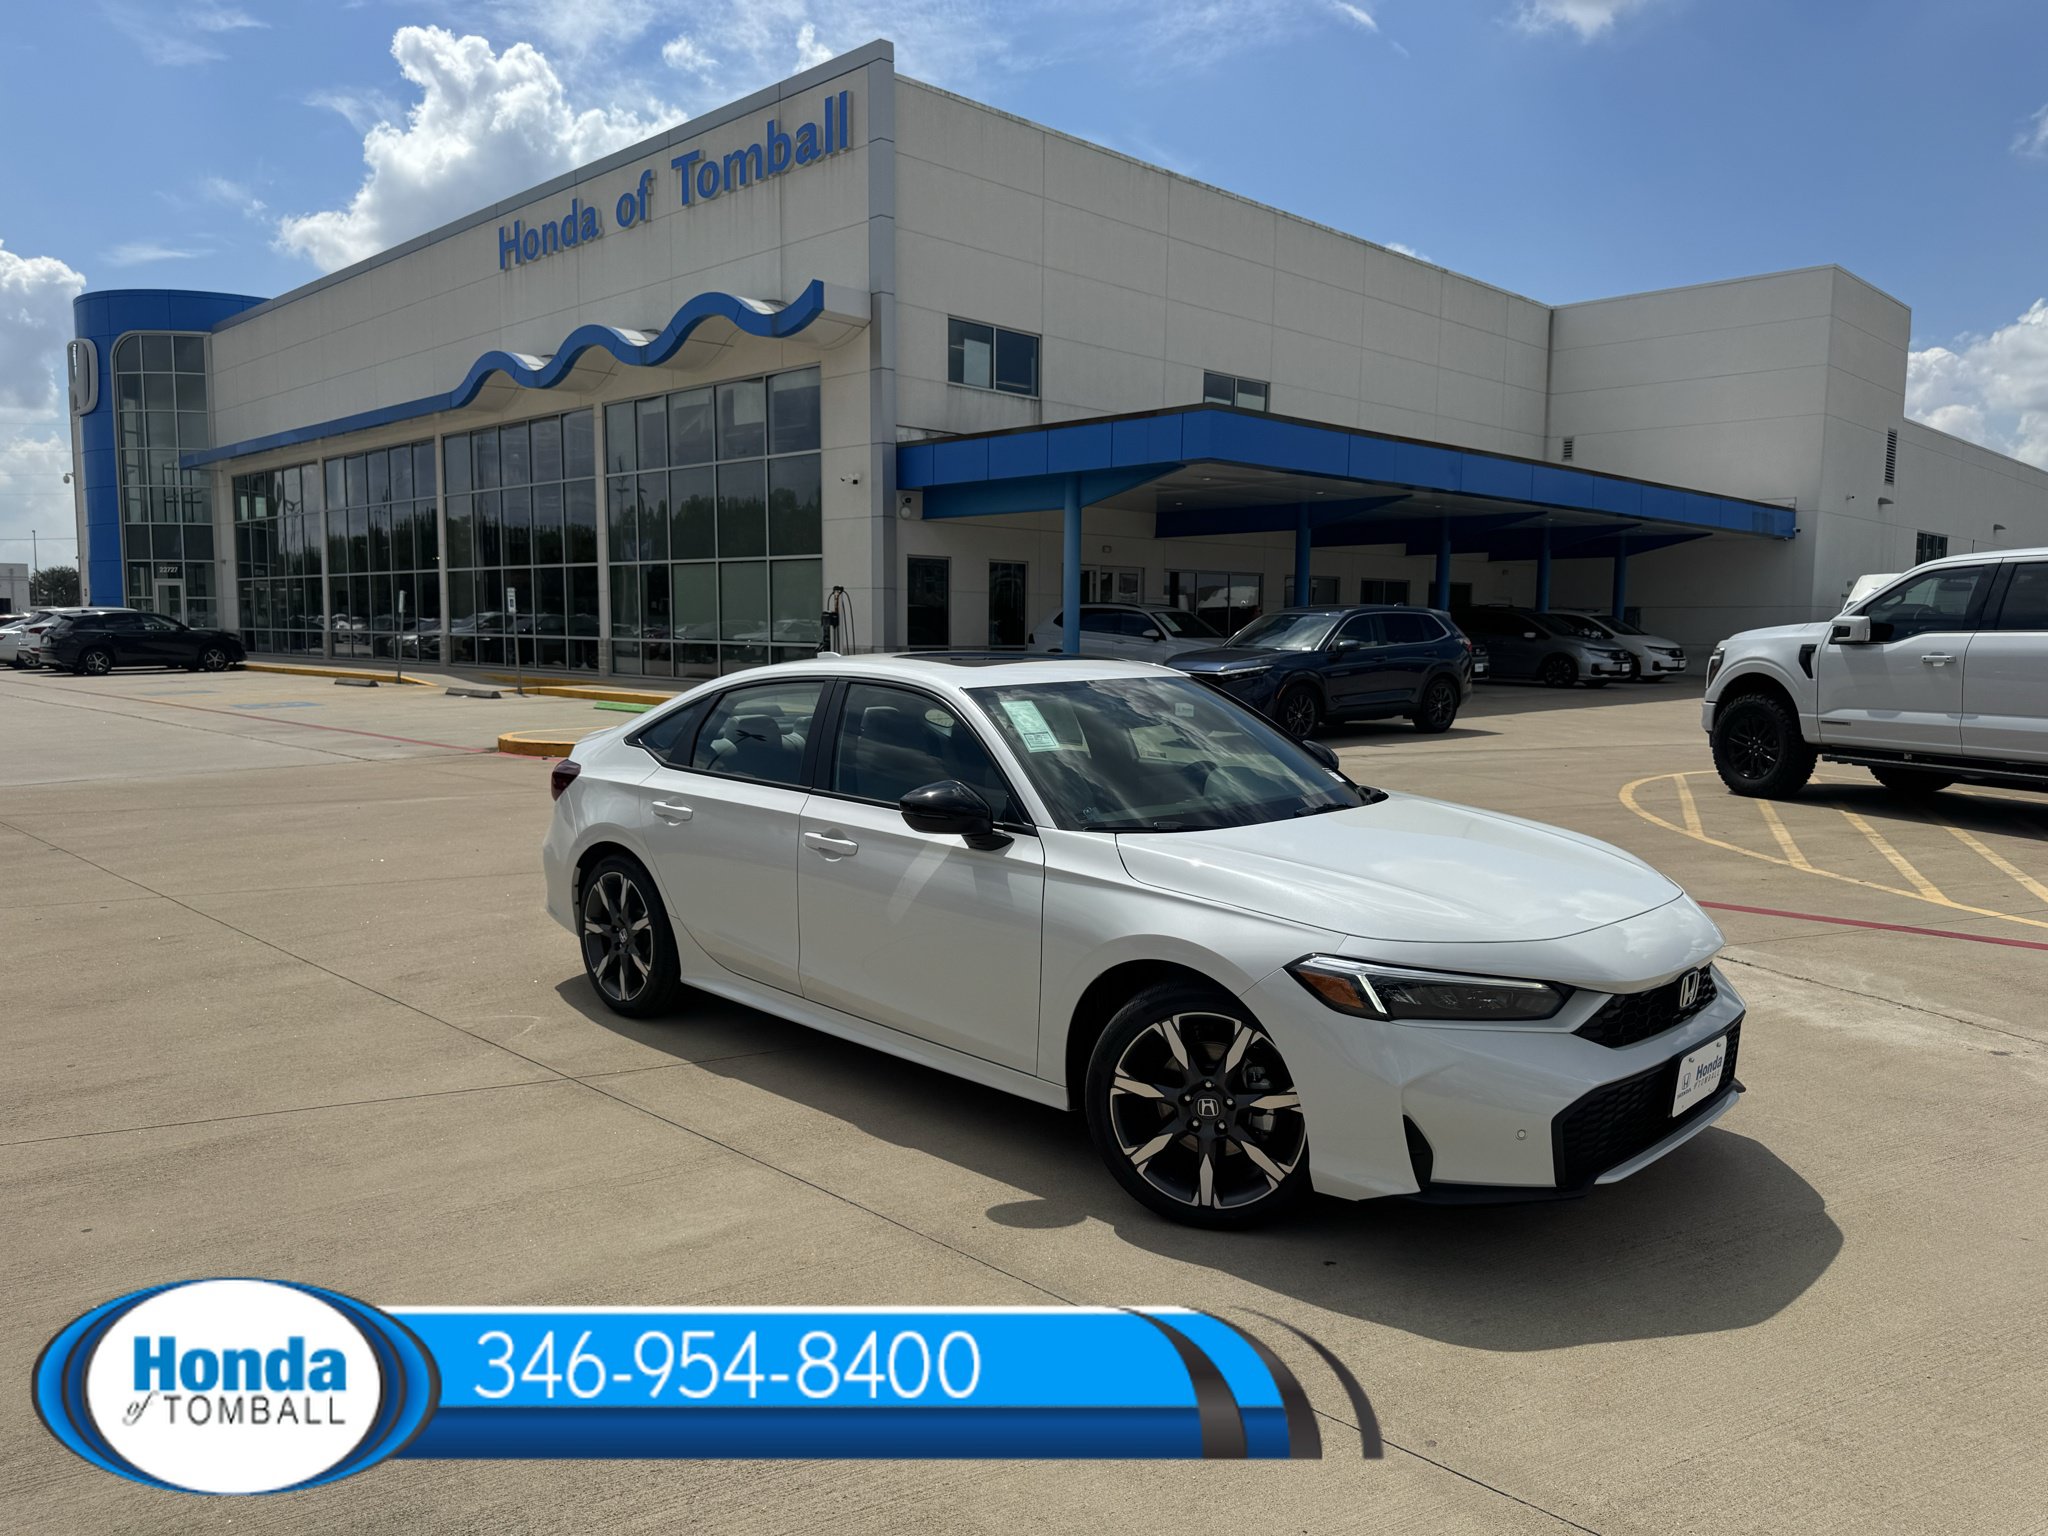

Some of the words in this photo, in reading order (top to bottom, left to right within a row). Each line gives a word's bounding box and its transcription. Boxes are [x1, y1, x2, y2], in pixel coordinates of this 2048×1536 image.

[498, 198, 600, 271] Honda
[615, 169, 653, 228] of
[671, 90, 849, 206] Tomball
[1696, 1055, 1722, 1080] Honda
